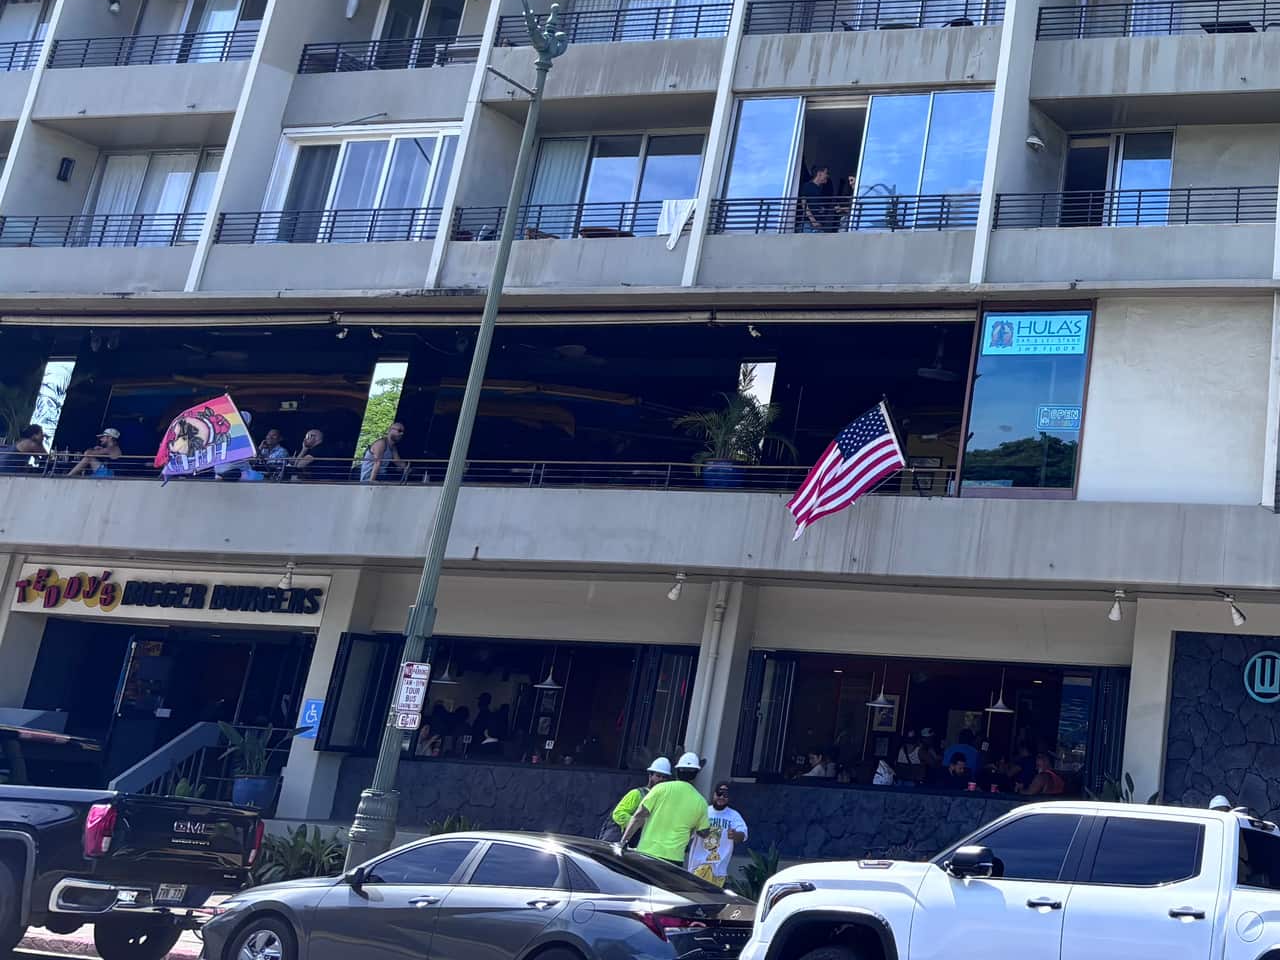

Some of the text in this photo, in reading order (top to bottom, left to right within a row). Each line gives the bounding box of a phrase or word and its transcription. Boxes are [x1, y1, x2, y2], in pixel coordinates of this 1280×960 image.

[1017, 320, 1081, 334] HULA'S
[121, 580, 208, 609] BIGGER
[209, 584, 323, 614] BURGERS
[405, 687, 420, 695] TOUR
[405, 695, 417, 703] BUS
